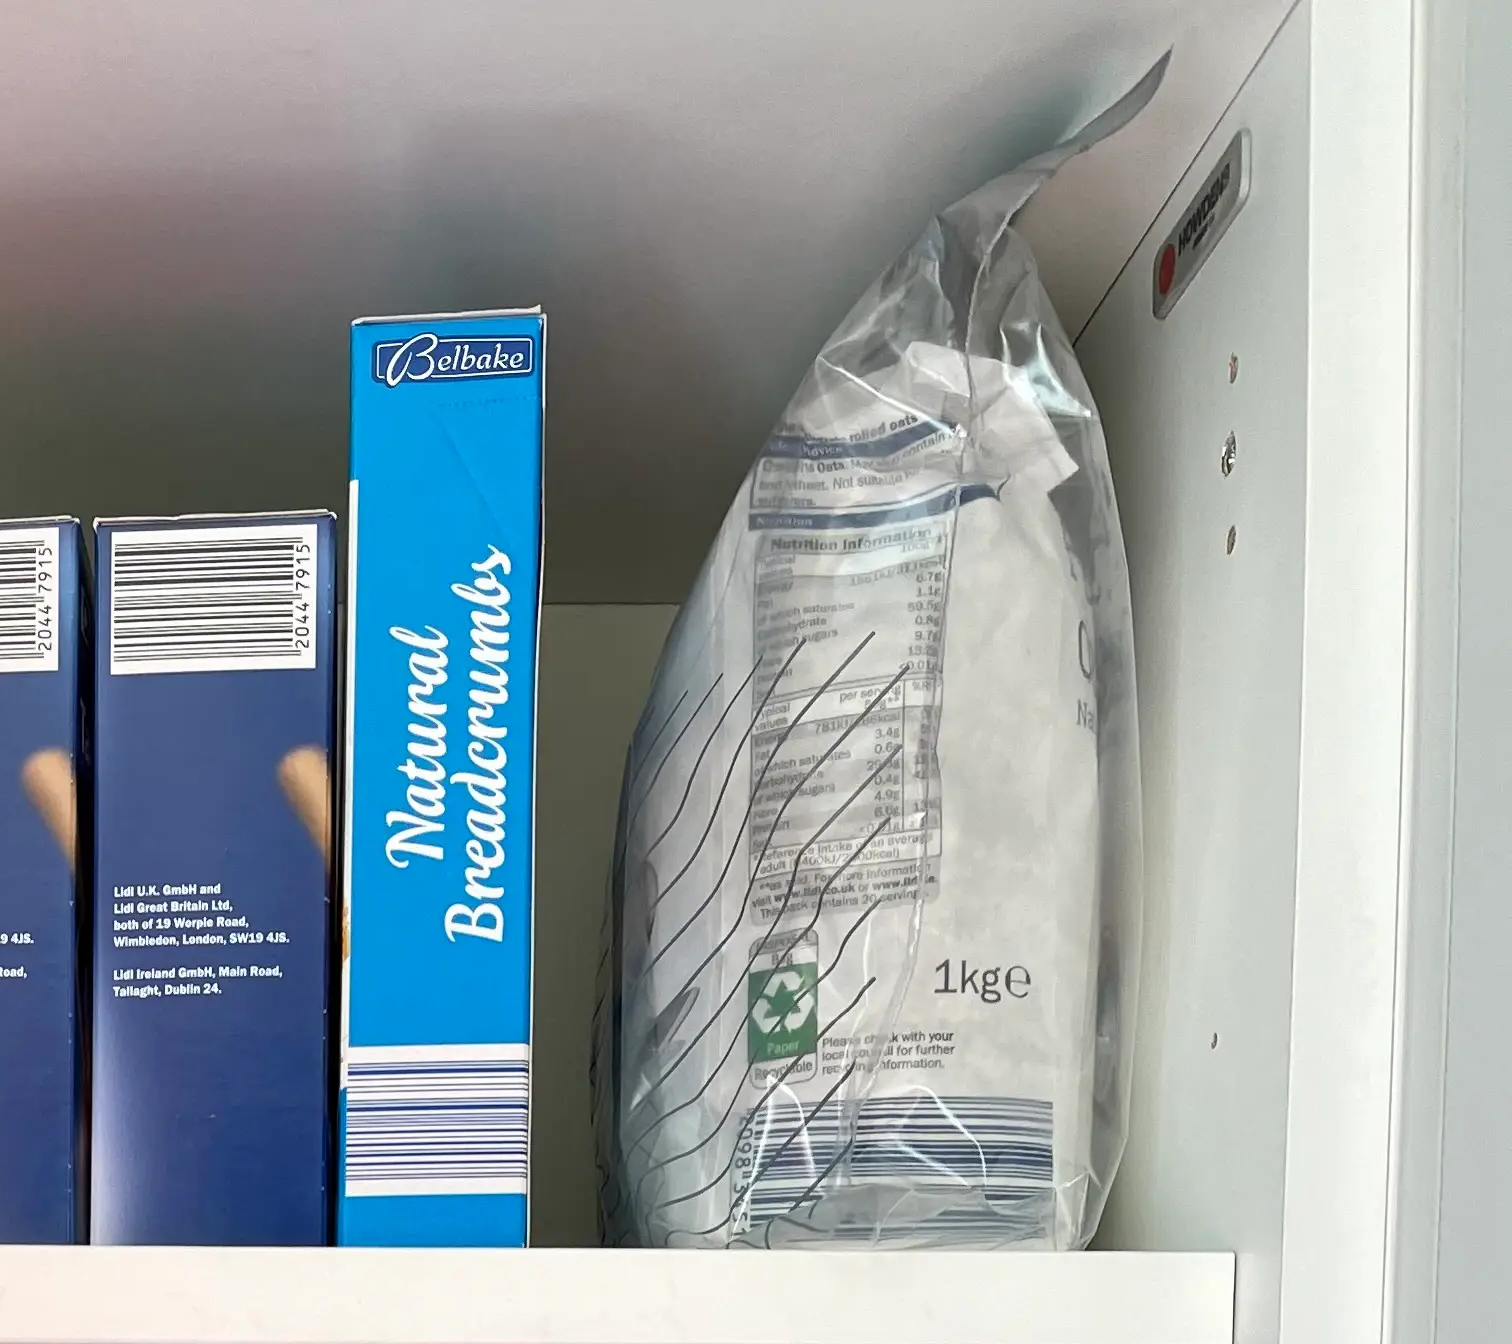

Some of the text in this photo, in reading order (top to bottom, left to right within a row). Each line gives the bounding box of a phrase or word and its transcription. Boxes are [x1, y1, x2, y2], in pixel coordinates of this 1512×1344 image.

[387, 333, 524, 386] Belbake
[38, 547, 52, 651] 2044 7915
[295, 544, 310, 649] 2044 7915
[385, 624, 450, 870] Natural
[444, 544, 512, 943] Breadcrumbs
[114, 884, 221, 898] Lidl U.K. GmbH and
[114, 900, 233, 914] Lidl Great Britain Ltd,
[897, 1044, 954, 1056] for further
[901, 1031, 954, 1044] with your
